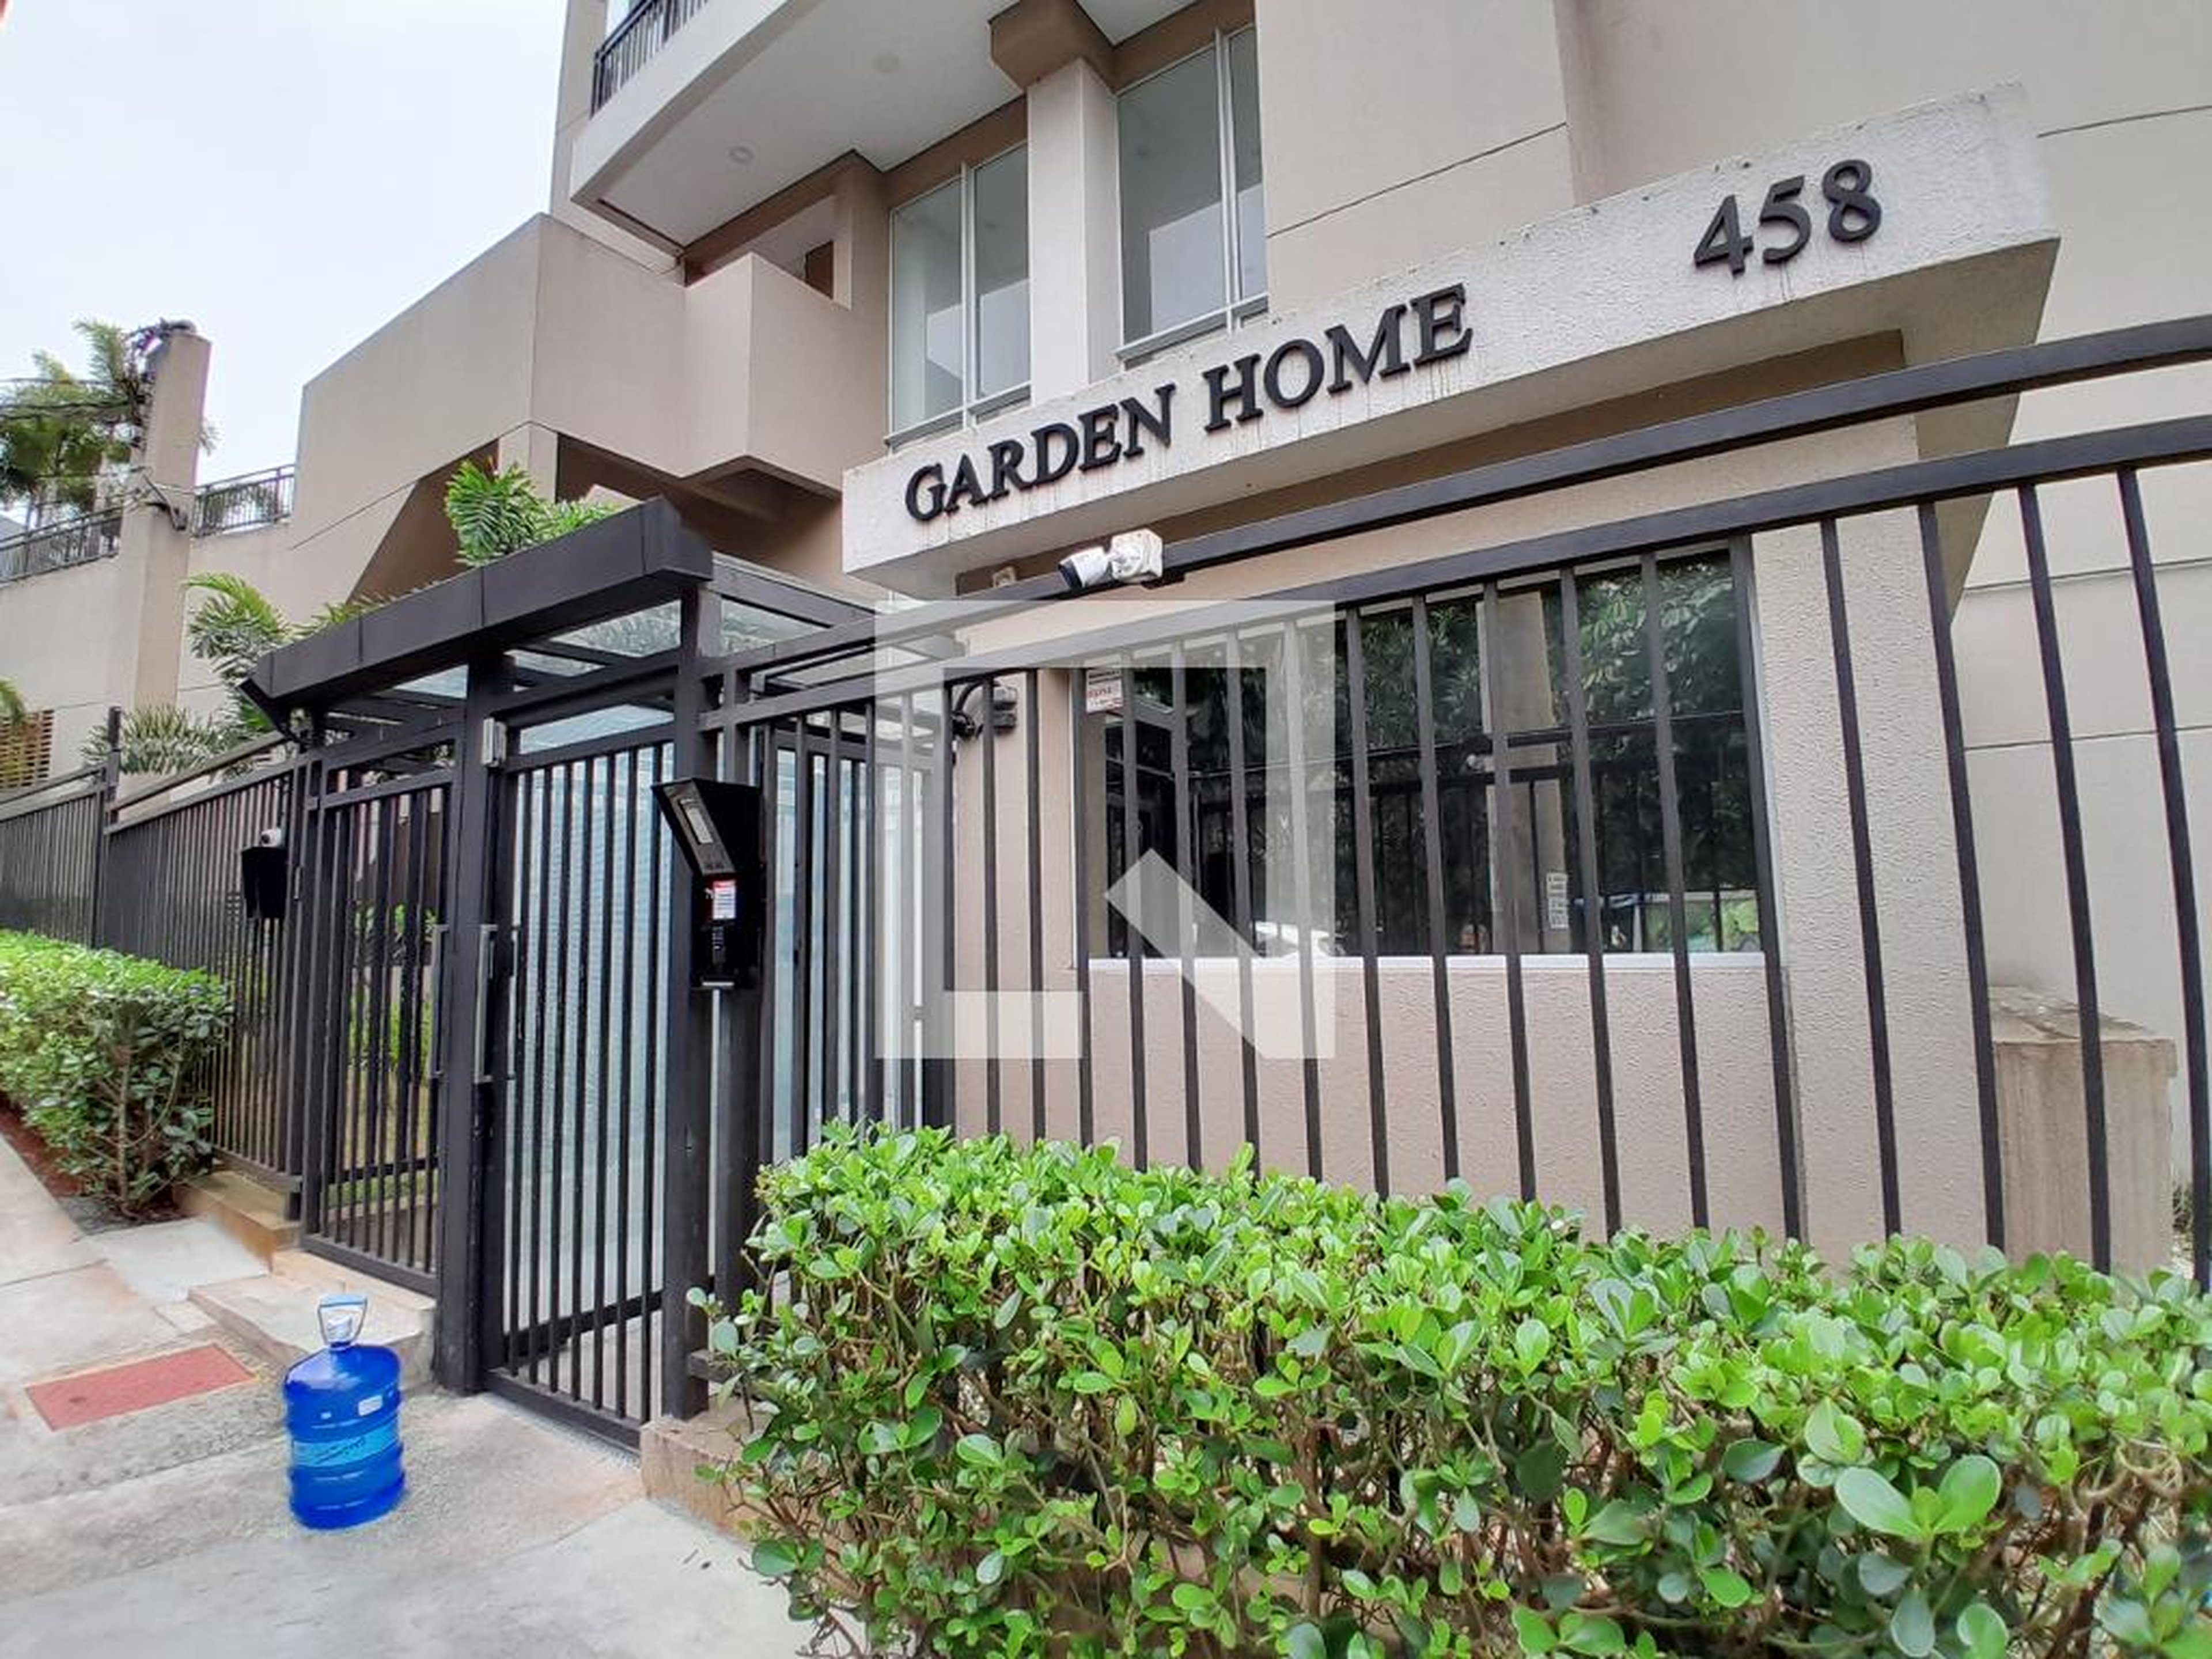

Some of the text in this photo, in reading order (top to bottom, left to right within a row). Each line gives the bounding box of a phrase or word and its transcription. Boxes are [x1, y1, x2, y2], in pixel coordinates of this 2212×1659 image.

[1694, 159, 1882, 275] 458
[905, 283, 1474, 522] GARDEN HOME
